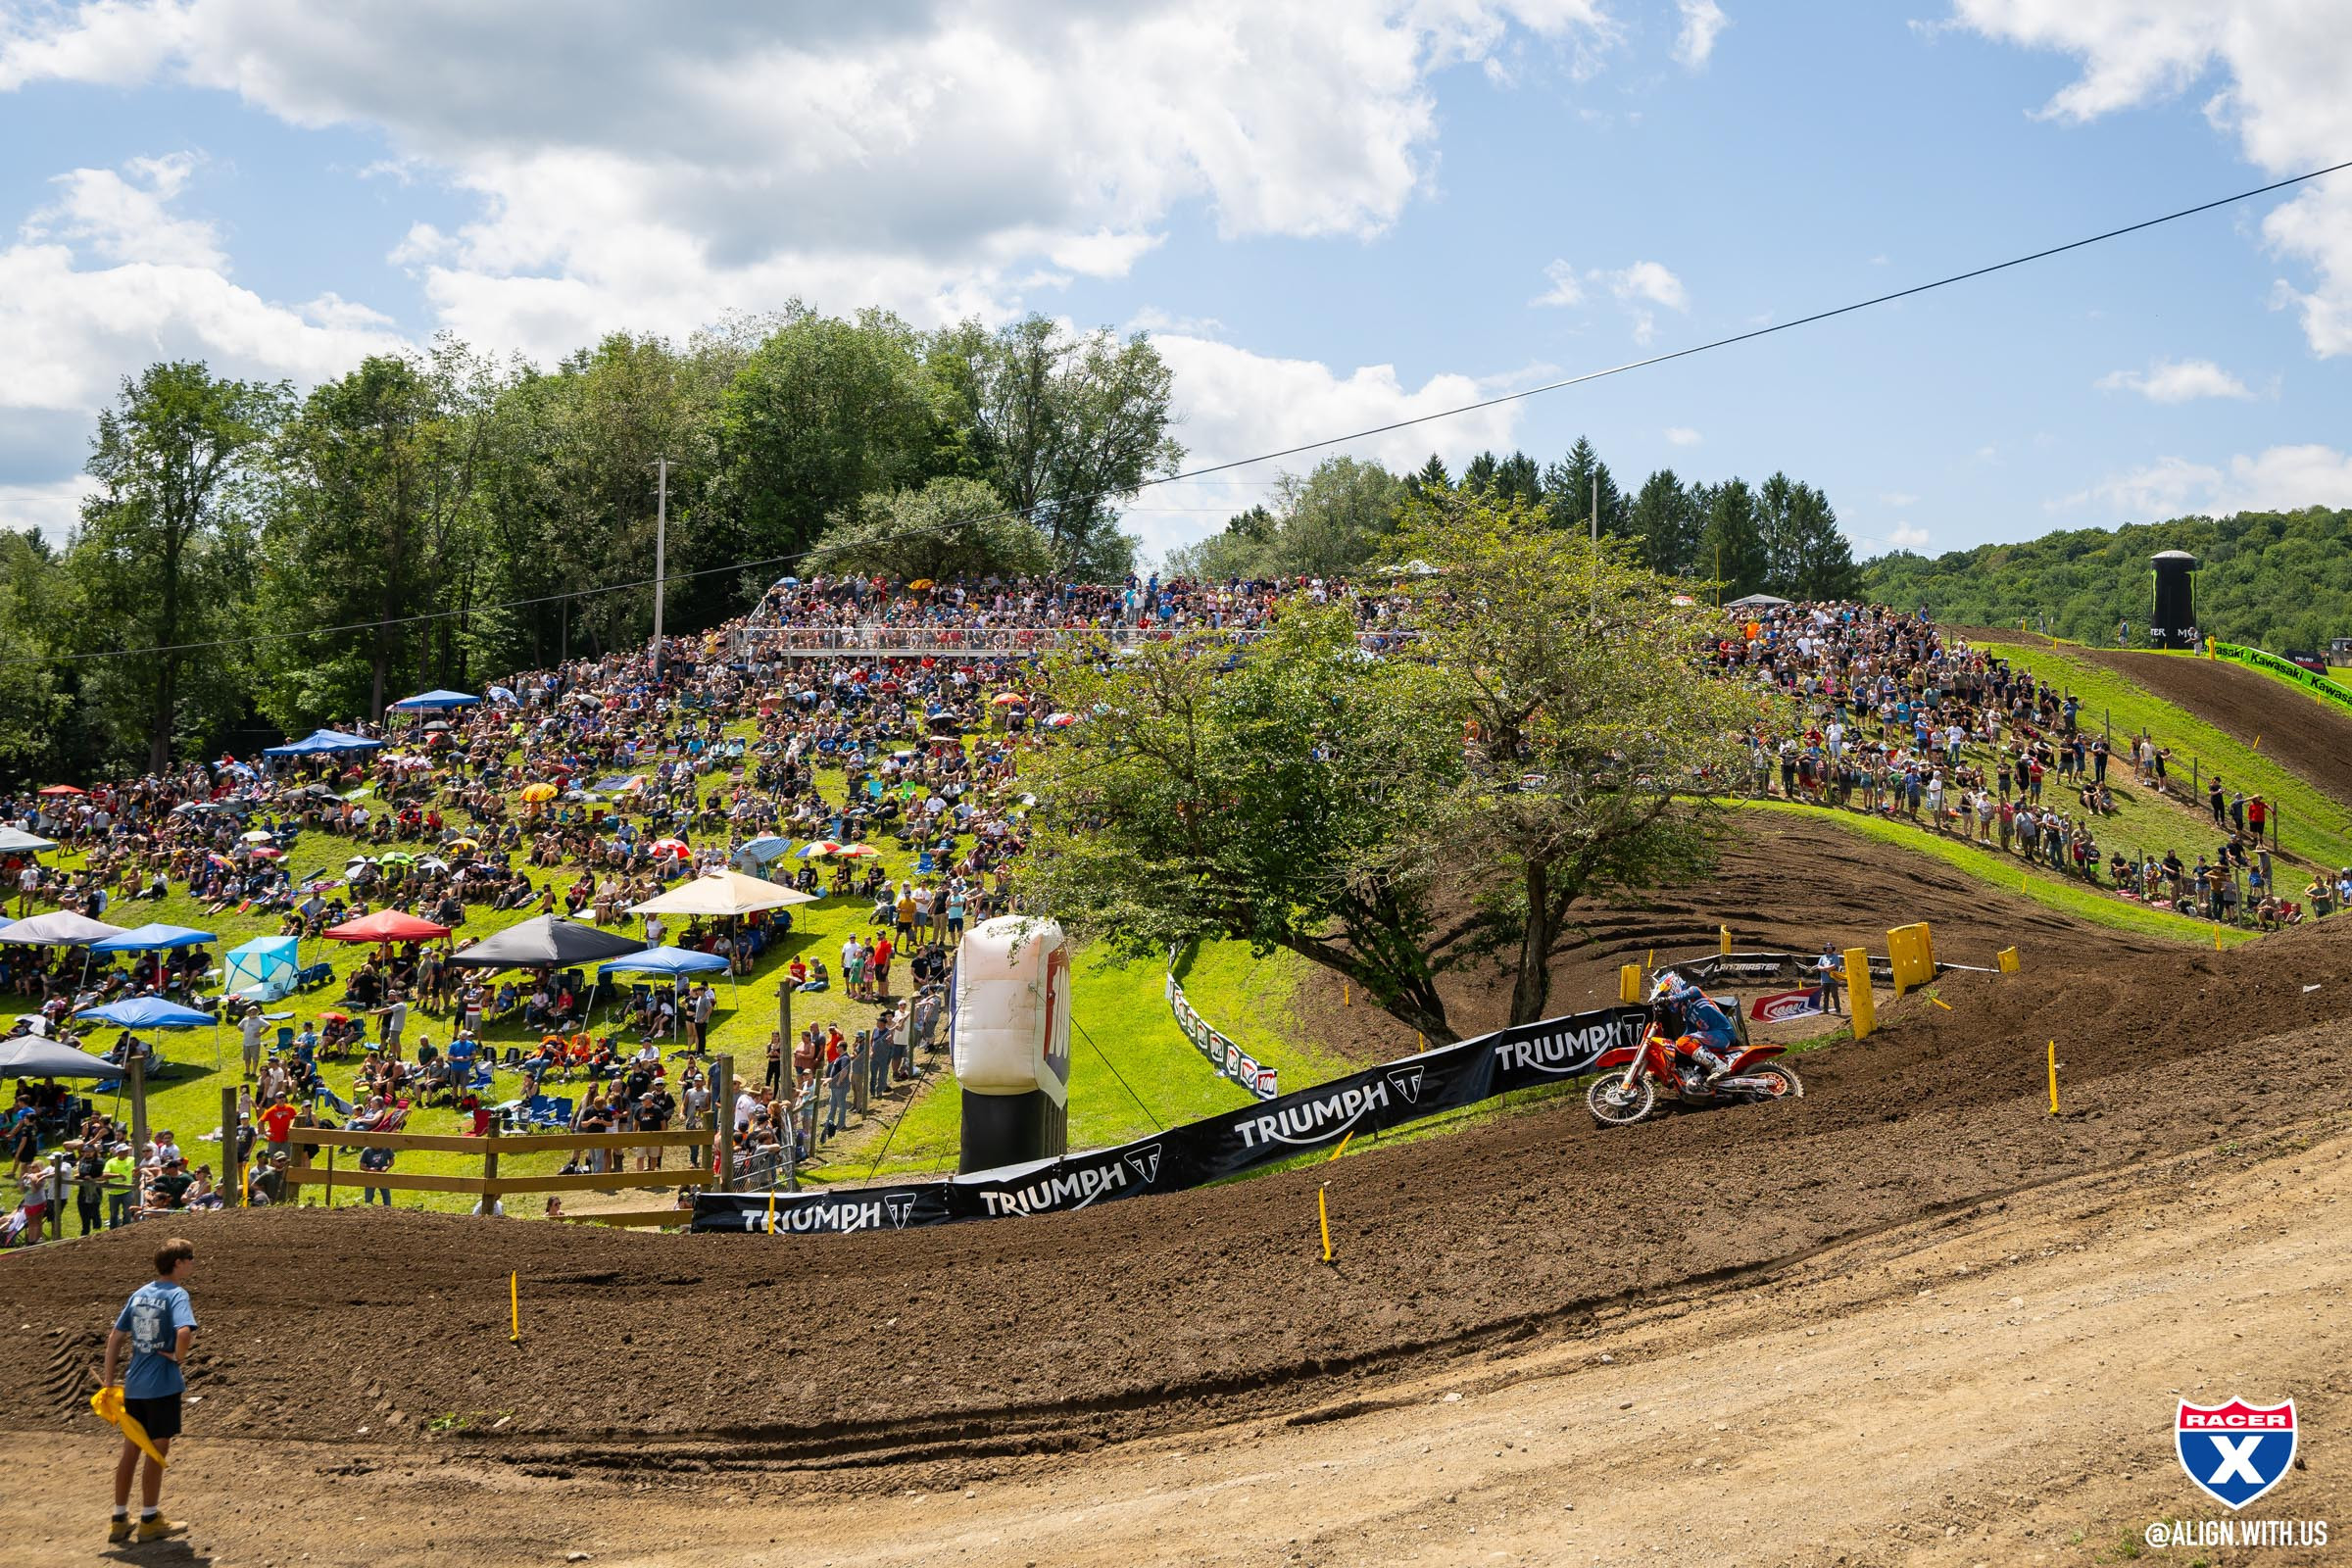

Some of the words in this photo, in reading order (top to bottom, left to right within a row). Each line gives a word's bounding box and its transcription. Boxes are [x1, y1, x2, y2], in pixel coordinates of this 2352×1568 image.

[2250, 652, 2304, 681] Kawasaki
[1713, 962, 1781, 973] LANDMASTER
[1494, 1020, 1624, 1072] TRIUMPH
[1234, 1082, 1390, 1144] TRIUMPH
[981, 1162, 1127, 1218] TRIUMPH
[741, 1201, 881, 1235] TRIUMPH
